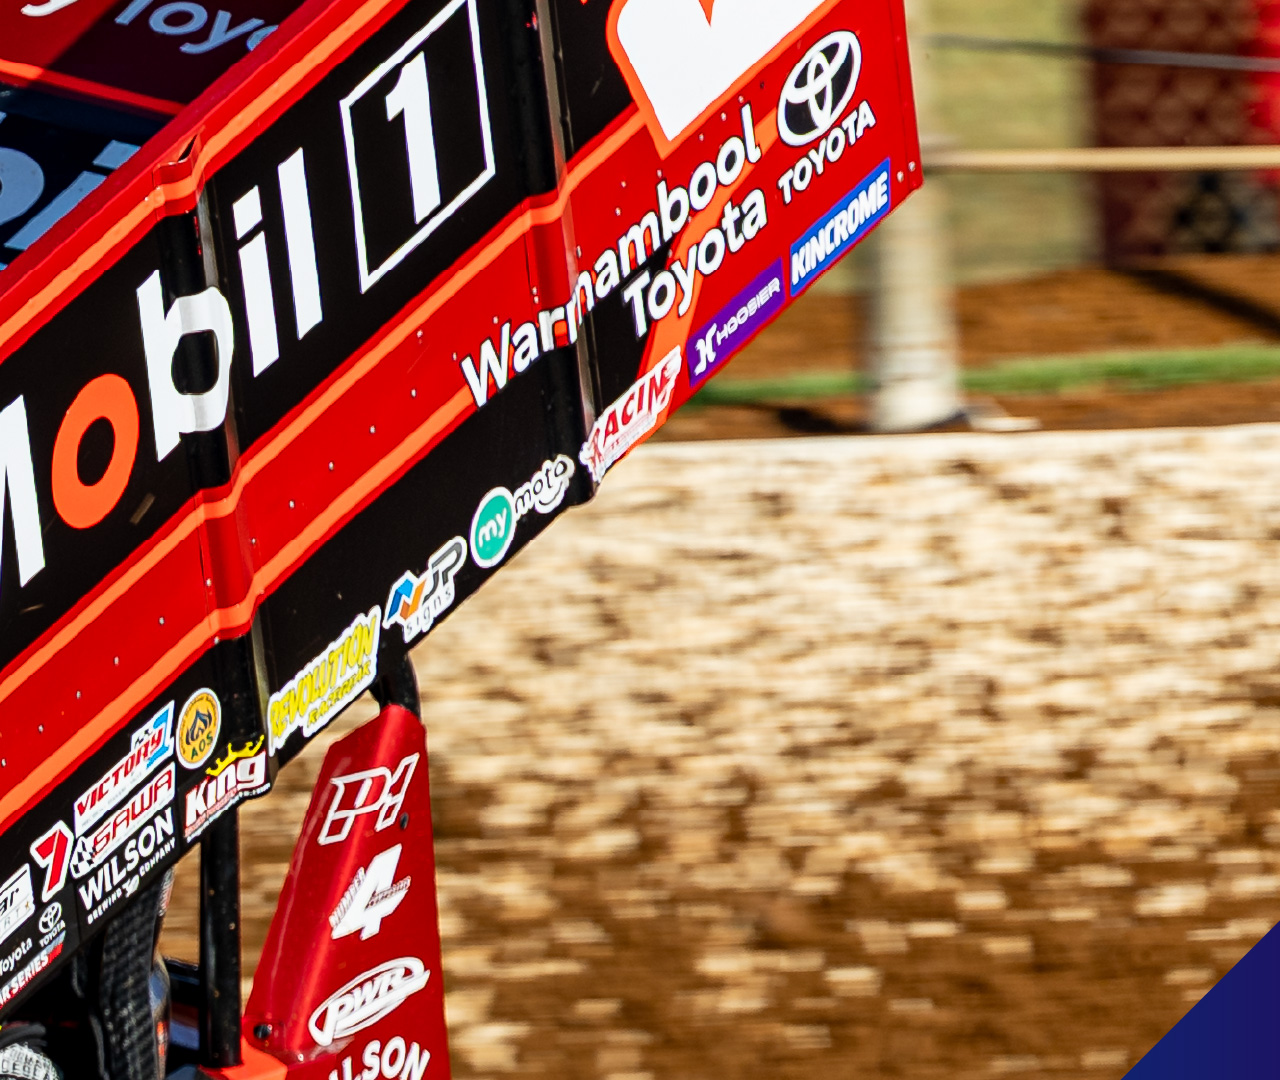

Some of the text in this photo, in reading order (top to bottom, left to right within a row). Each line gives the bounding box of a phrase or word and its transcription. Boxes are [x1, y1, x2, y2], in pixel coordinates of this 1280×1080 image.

[385, 51, 440, 224] 1
[778, 101, 876, 204] TOYOTA
[624, 189, 767, 338] Toyota
[791, 171, 888, 285] KINCROME
[716, 278, 780, 346] HOOSIER
[270, 615, 377, 740] REVOLUTION
[185, 749, 267, 828] King
[191, 731, 214, 760] AOS
[79, 807, 175, 912] WILSON
[139, 836, 176, 877] COMPANY
[331, 843, 403, 941] 4
[11, 952, 49, 995] SERIES
[317, 962, 420, 1043] PWR
